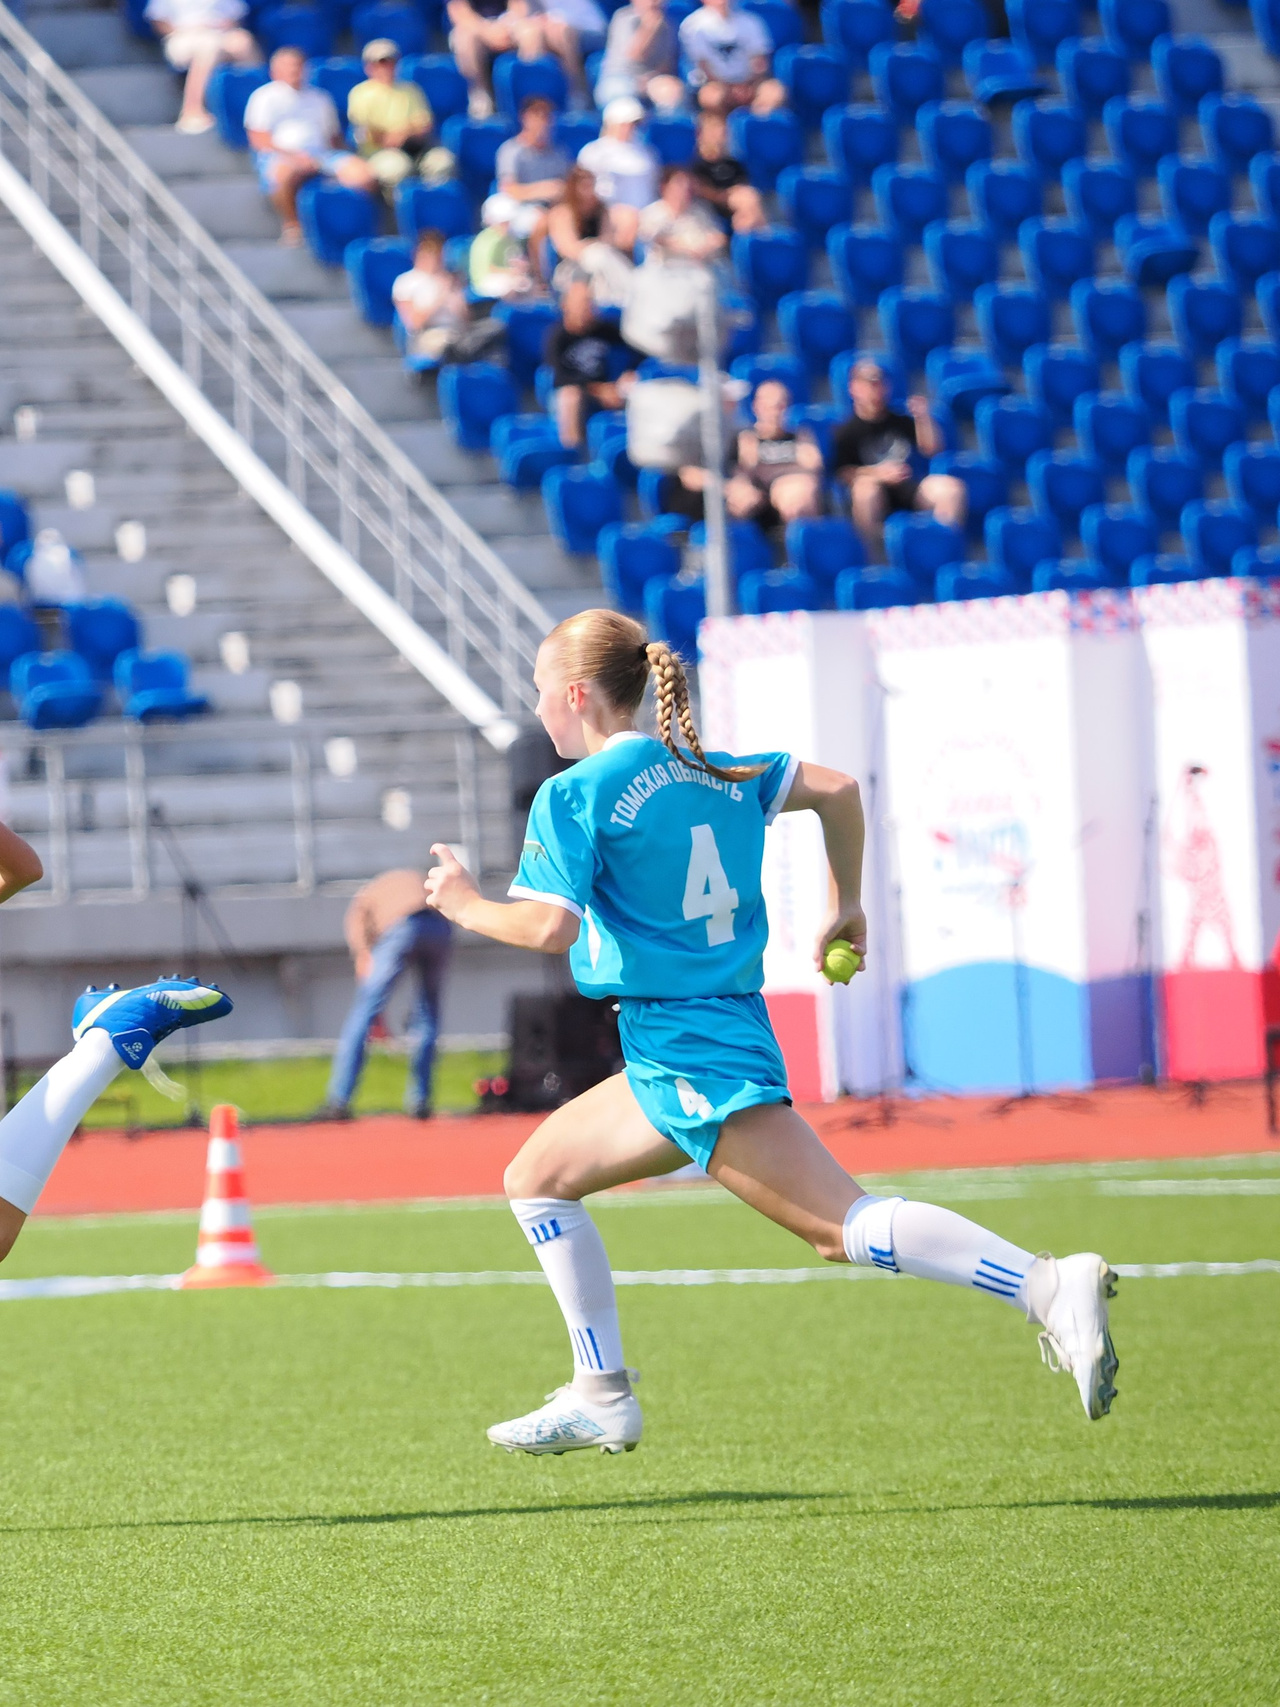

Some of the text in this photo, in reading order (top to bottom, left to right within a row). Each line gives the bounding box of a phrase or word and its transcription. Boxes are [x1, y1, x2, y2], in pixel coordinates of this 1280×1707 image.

[609, 764, 672, 828] ТОМСКАЯ
[682, 824, 739, 947] 4
[674, 1077, 715, 1120] 4
